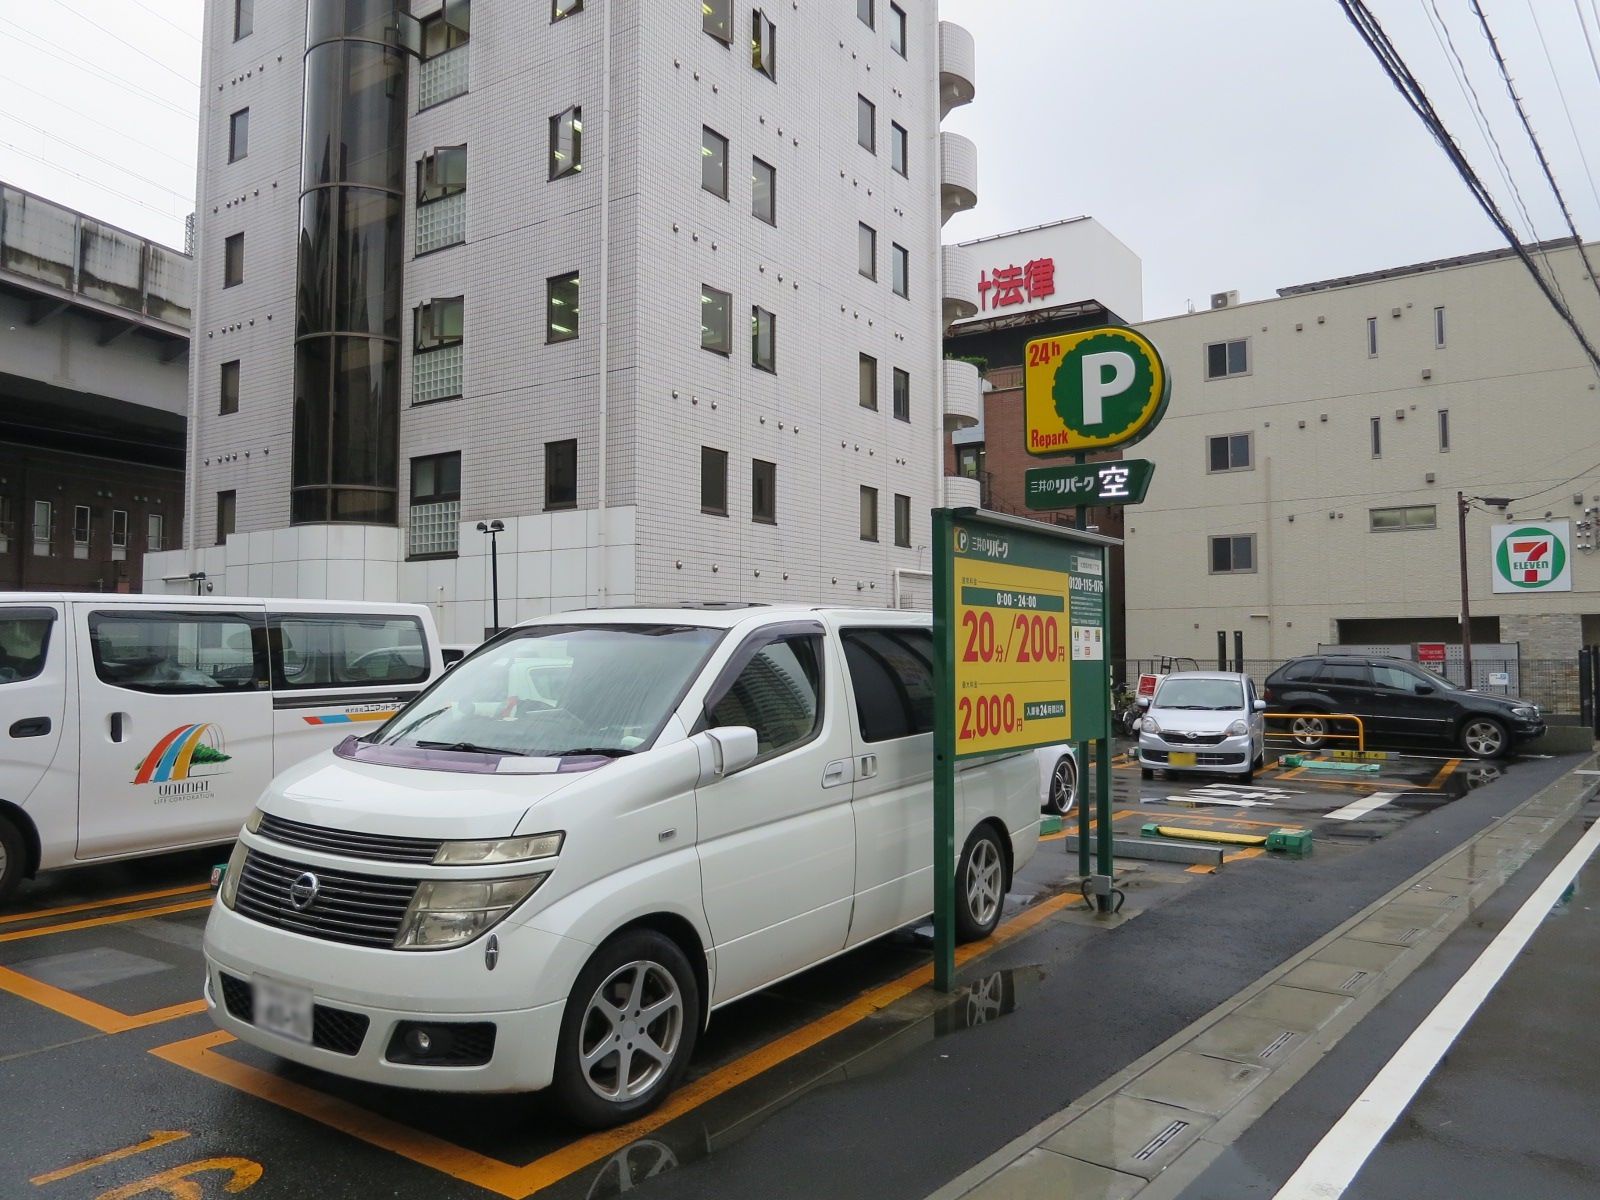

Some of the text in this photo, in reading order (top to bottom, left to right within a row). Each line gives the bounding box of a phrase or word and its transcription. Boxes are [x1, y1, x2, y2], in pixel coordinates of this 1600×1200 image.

[1081, 351, 1136, 426] P
[1031, 429, 1068, 448] Repark
[1030, 476, 1095, 494] 三井のリパーク
[1098, 466, 1129, 497] 空
[971, 536, 1009, 559] 三井のリパーク
